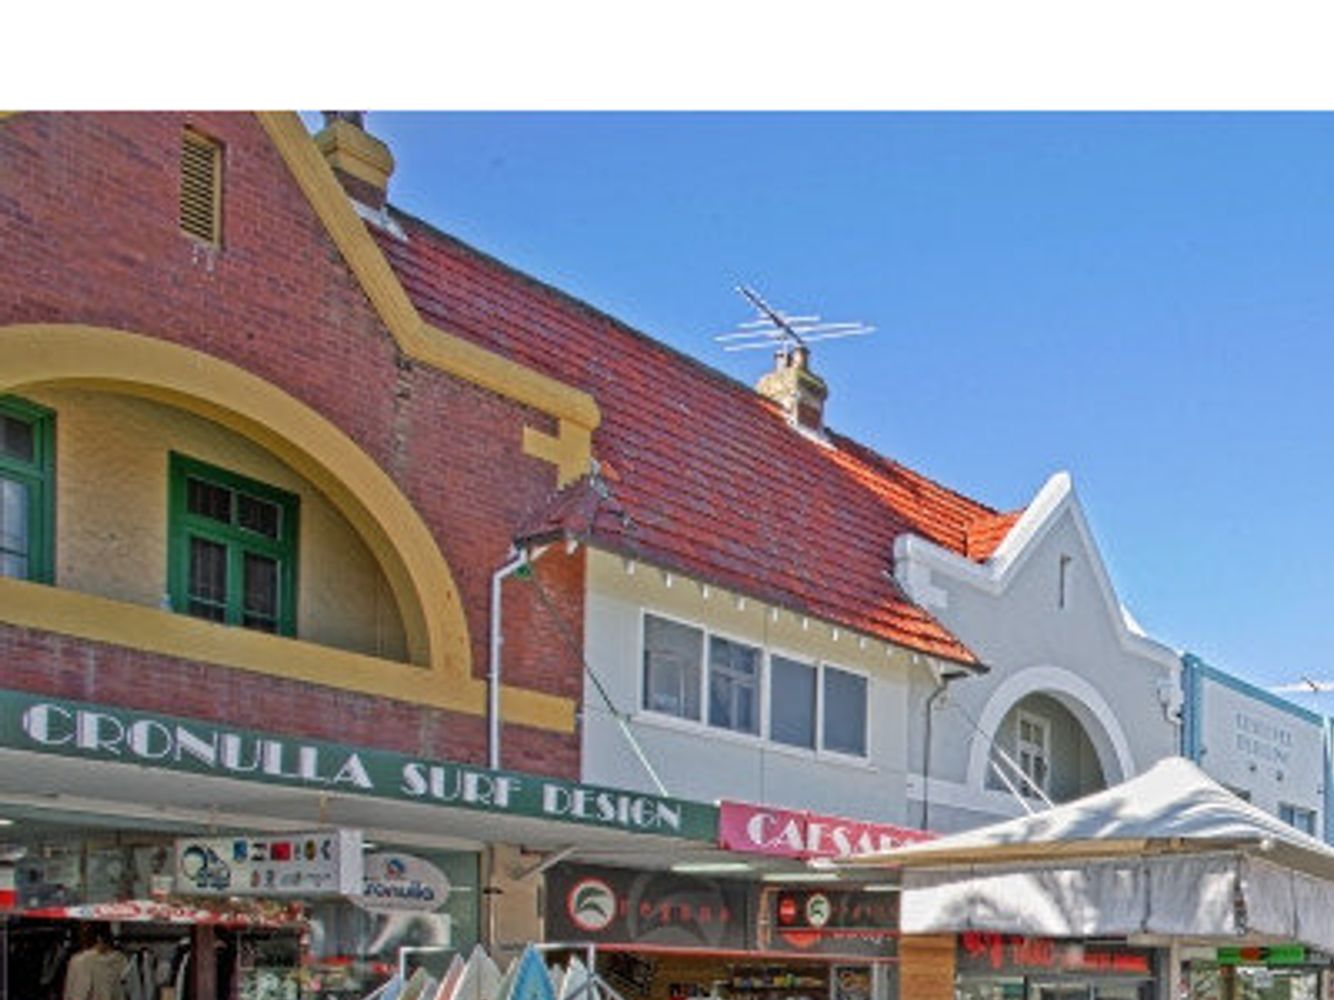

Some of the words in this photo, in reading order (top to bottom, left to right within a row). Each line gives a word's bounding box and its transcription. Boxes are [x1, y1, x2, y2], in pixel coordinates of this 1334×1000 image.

[22, 703, 374, 789] CRONULLA
[401, 762, 521, 808] SURF
[543, 782, 682, 831] DESIGN
